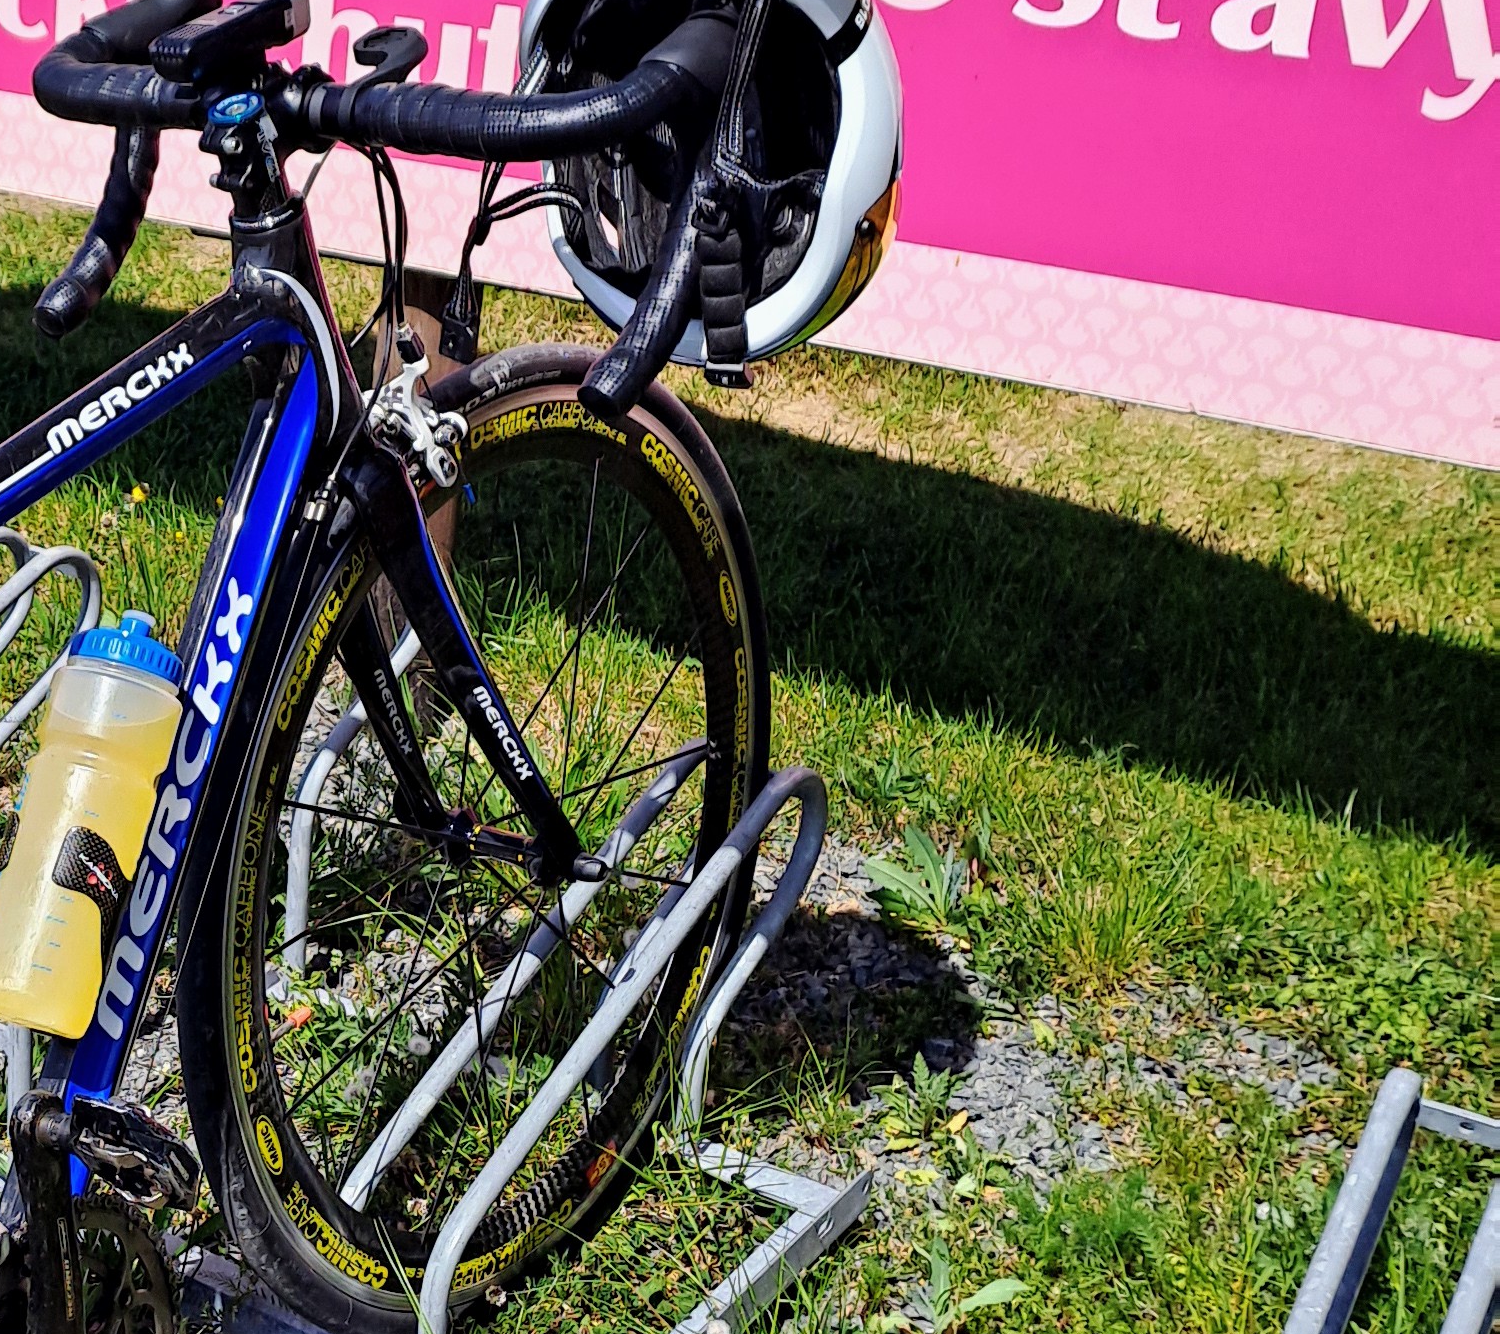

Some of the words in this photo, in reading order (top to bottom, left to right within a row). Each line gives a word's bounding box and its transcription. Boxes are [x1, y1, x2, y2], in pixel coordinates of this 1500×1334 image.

[44, 341, 195, 457] MERCKX
[372, 667, 414, 756] MERCKX
[472, 685, 535, 782] MERCKX
[96, 575, 255, 1042] MERCKX
